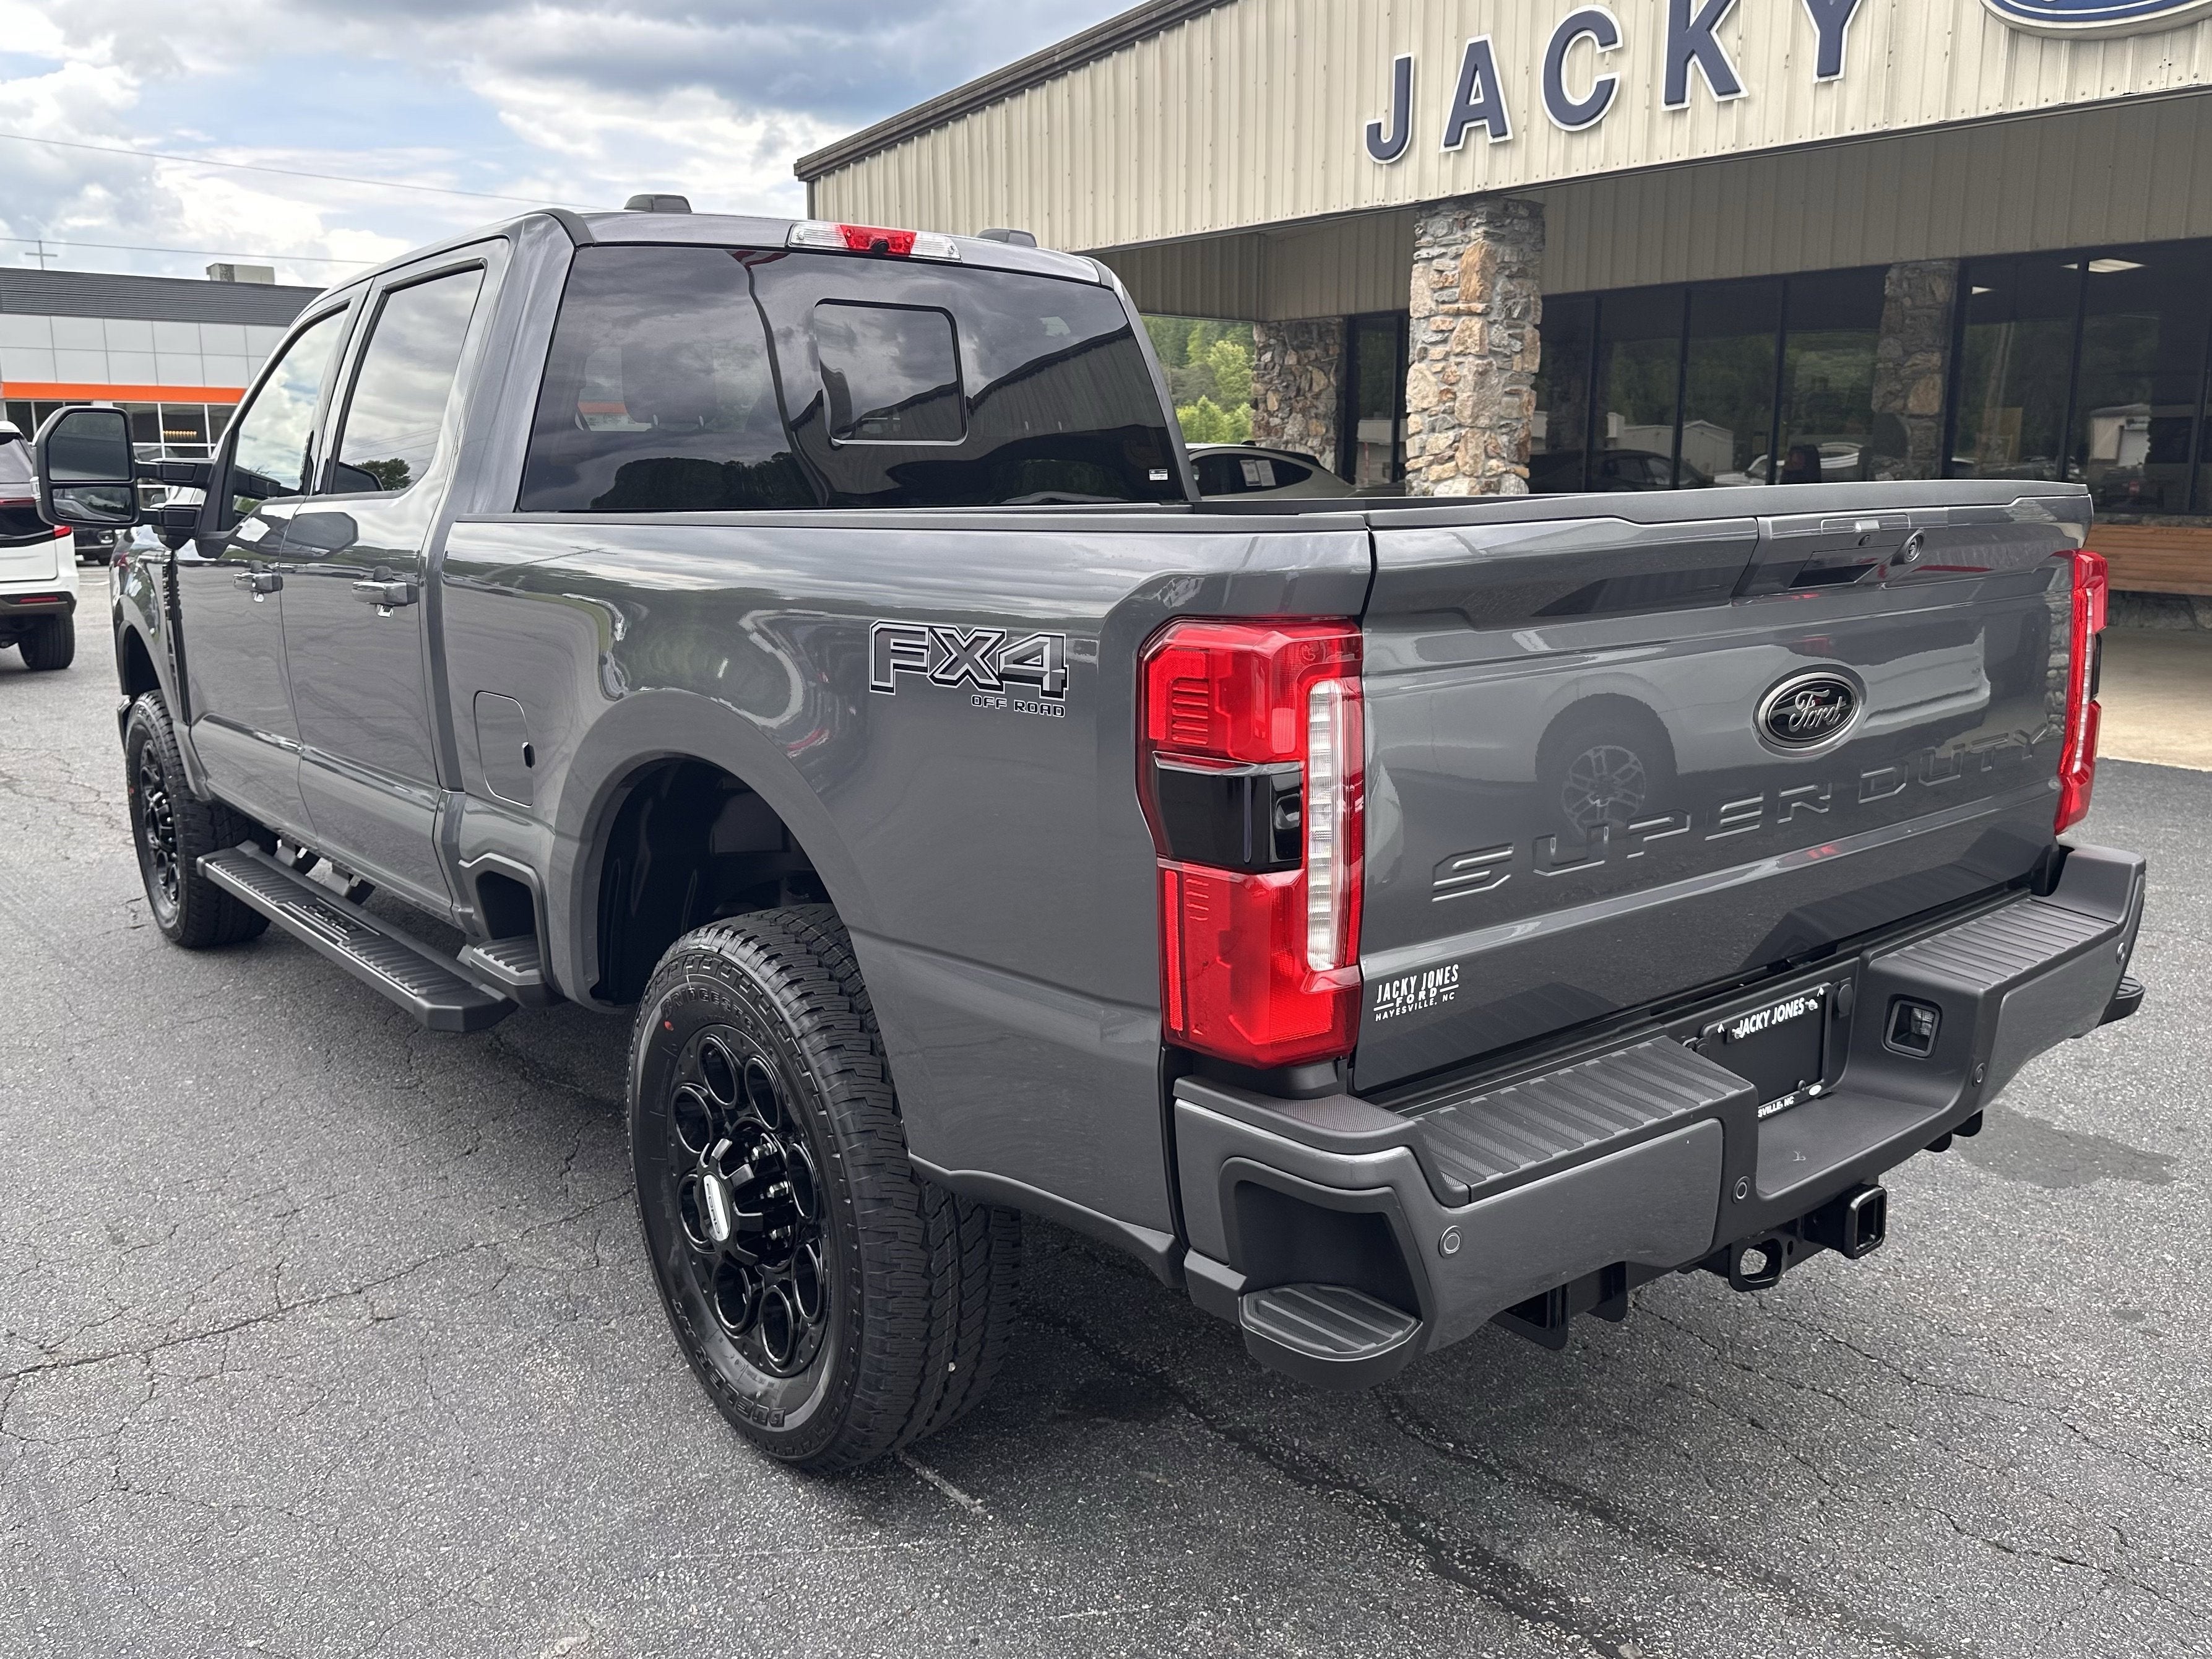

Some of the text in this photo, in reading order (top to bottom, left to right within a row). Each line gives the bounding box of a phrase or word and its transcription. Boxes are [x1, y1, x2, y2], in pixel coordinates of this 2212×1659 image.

[1365, 0, 1859, 165] JACKY
[870, 619, 1069, 701] FX4
[971, 694, 1066, 717] OFF ROAD
[1789, 689, 1847, 733] Ford
[1432, 721, 2049, 903] SUPER DUTY
[1376, 964, 1459, 1003] JACKY JONES
[1396, 987, 1437, 1007] FORD
[1442, 992, 1455, 1002] NC
[1739, 997, 1805, 1038] JACKY JONES
[1784, 1096, 1794, 1107] NC
[695, 1346, 787, 1428] DUELER
